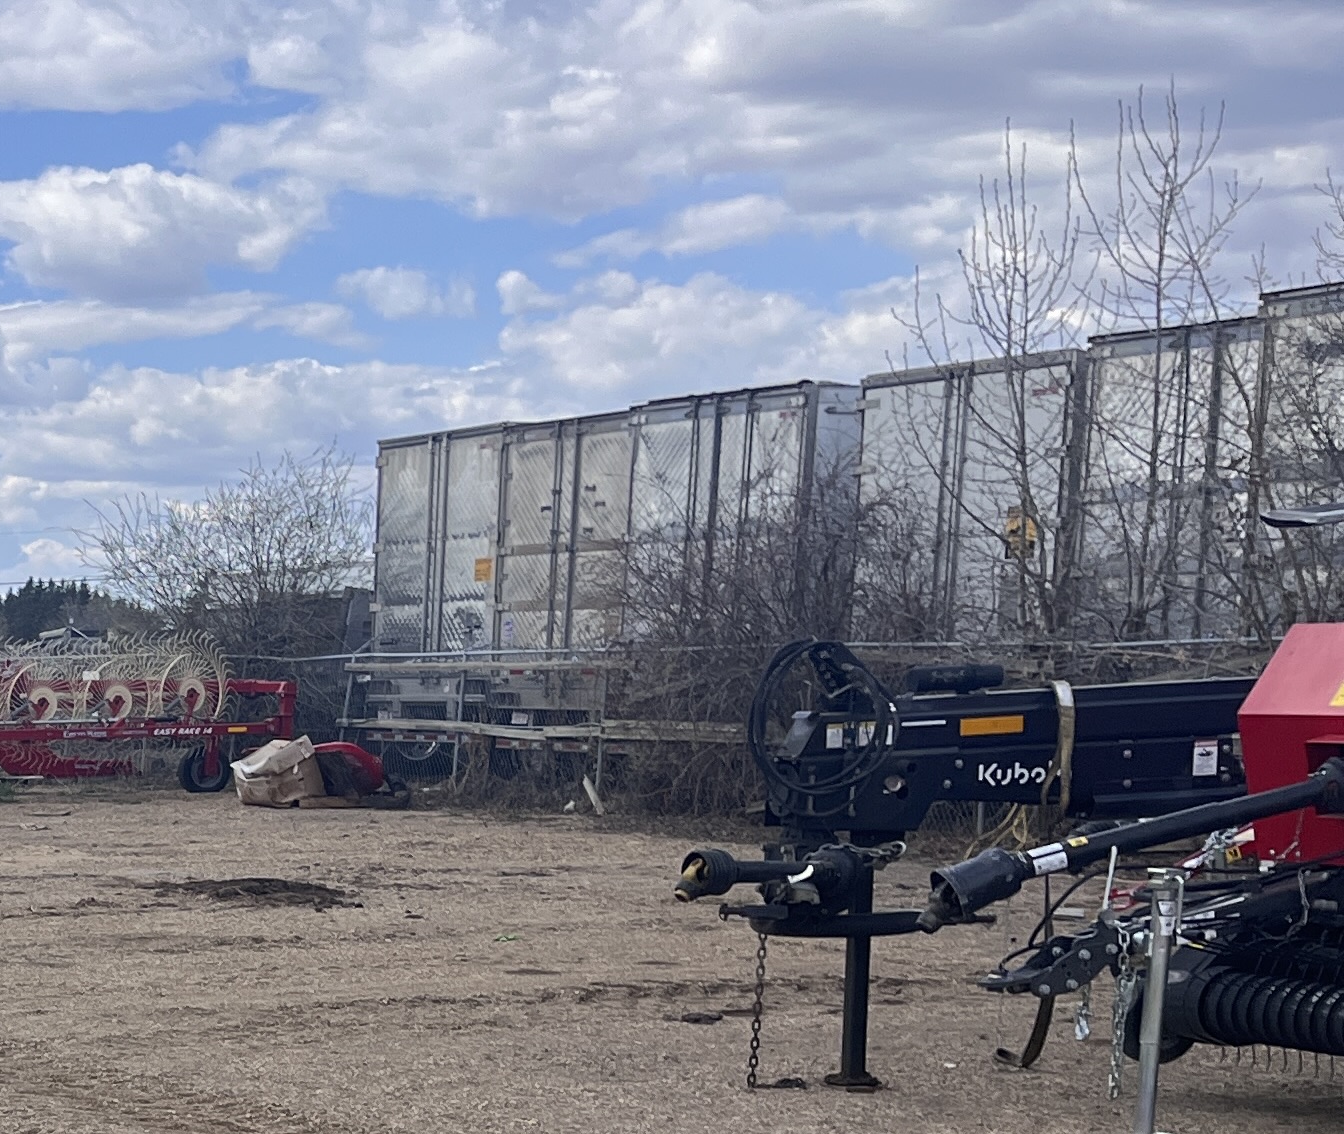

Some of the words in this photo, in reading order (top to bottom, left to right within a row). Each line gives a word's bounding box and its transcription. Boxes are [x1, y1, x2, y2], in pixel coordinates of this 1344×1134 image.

[153, 728, 177, 736] EASY
[177, 727, 201, 735] RAKE
[978, 760, 1063, 786] Kubo
